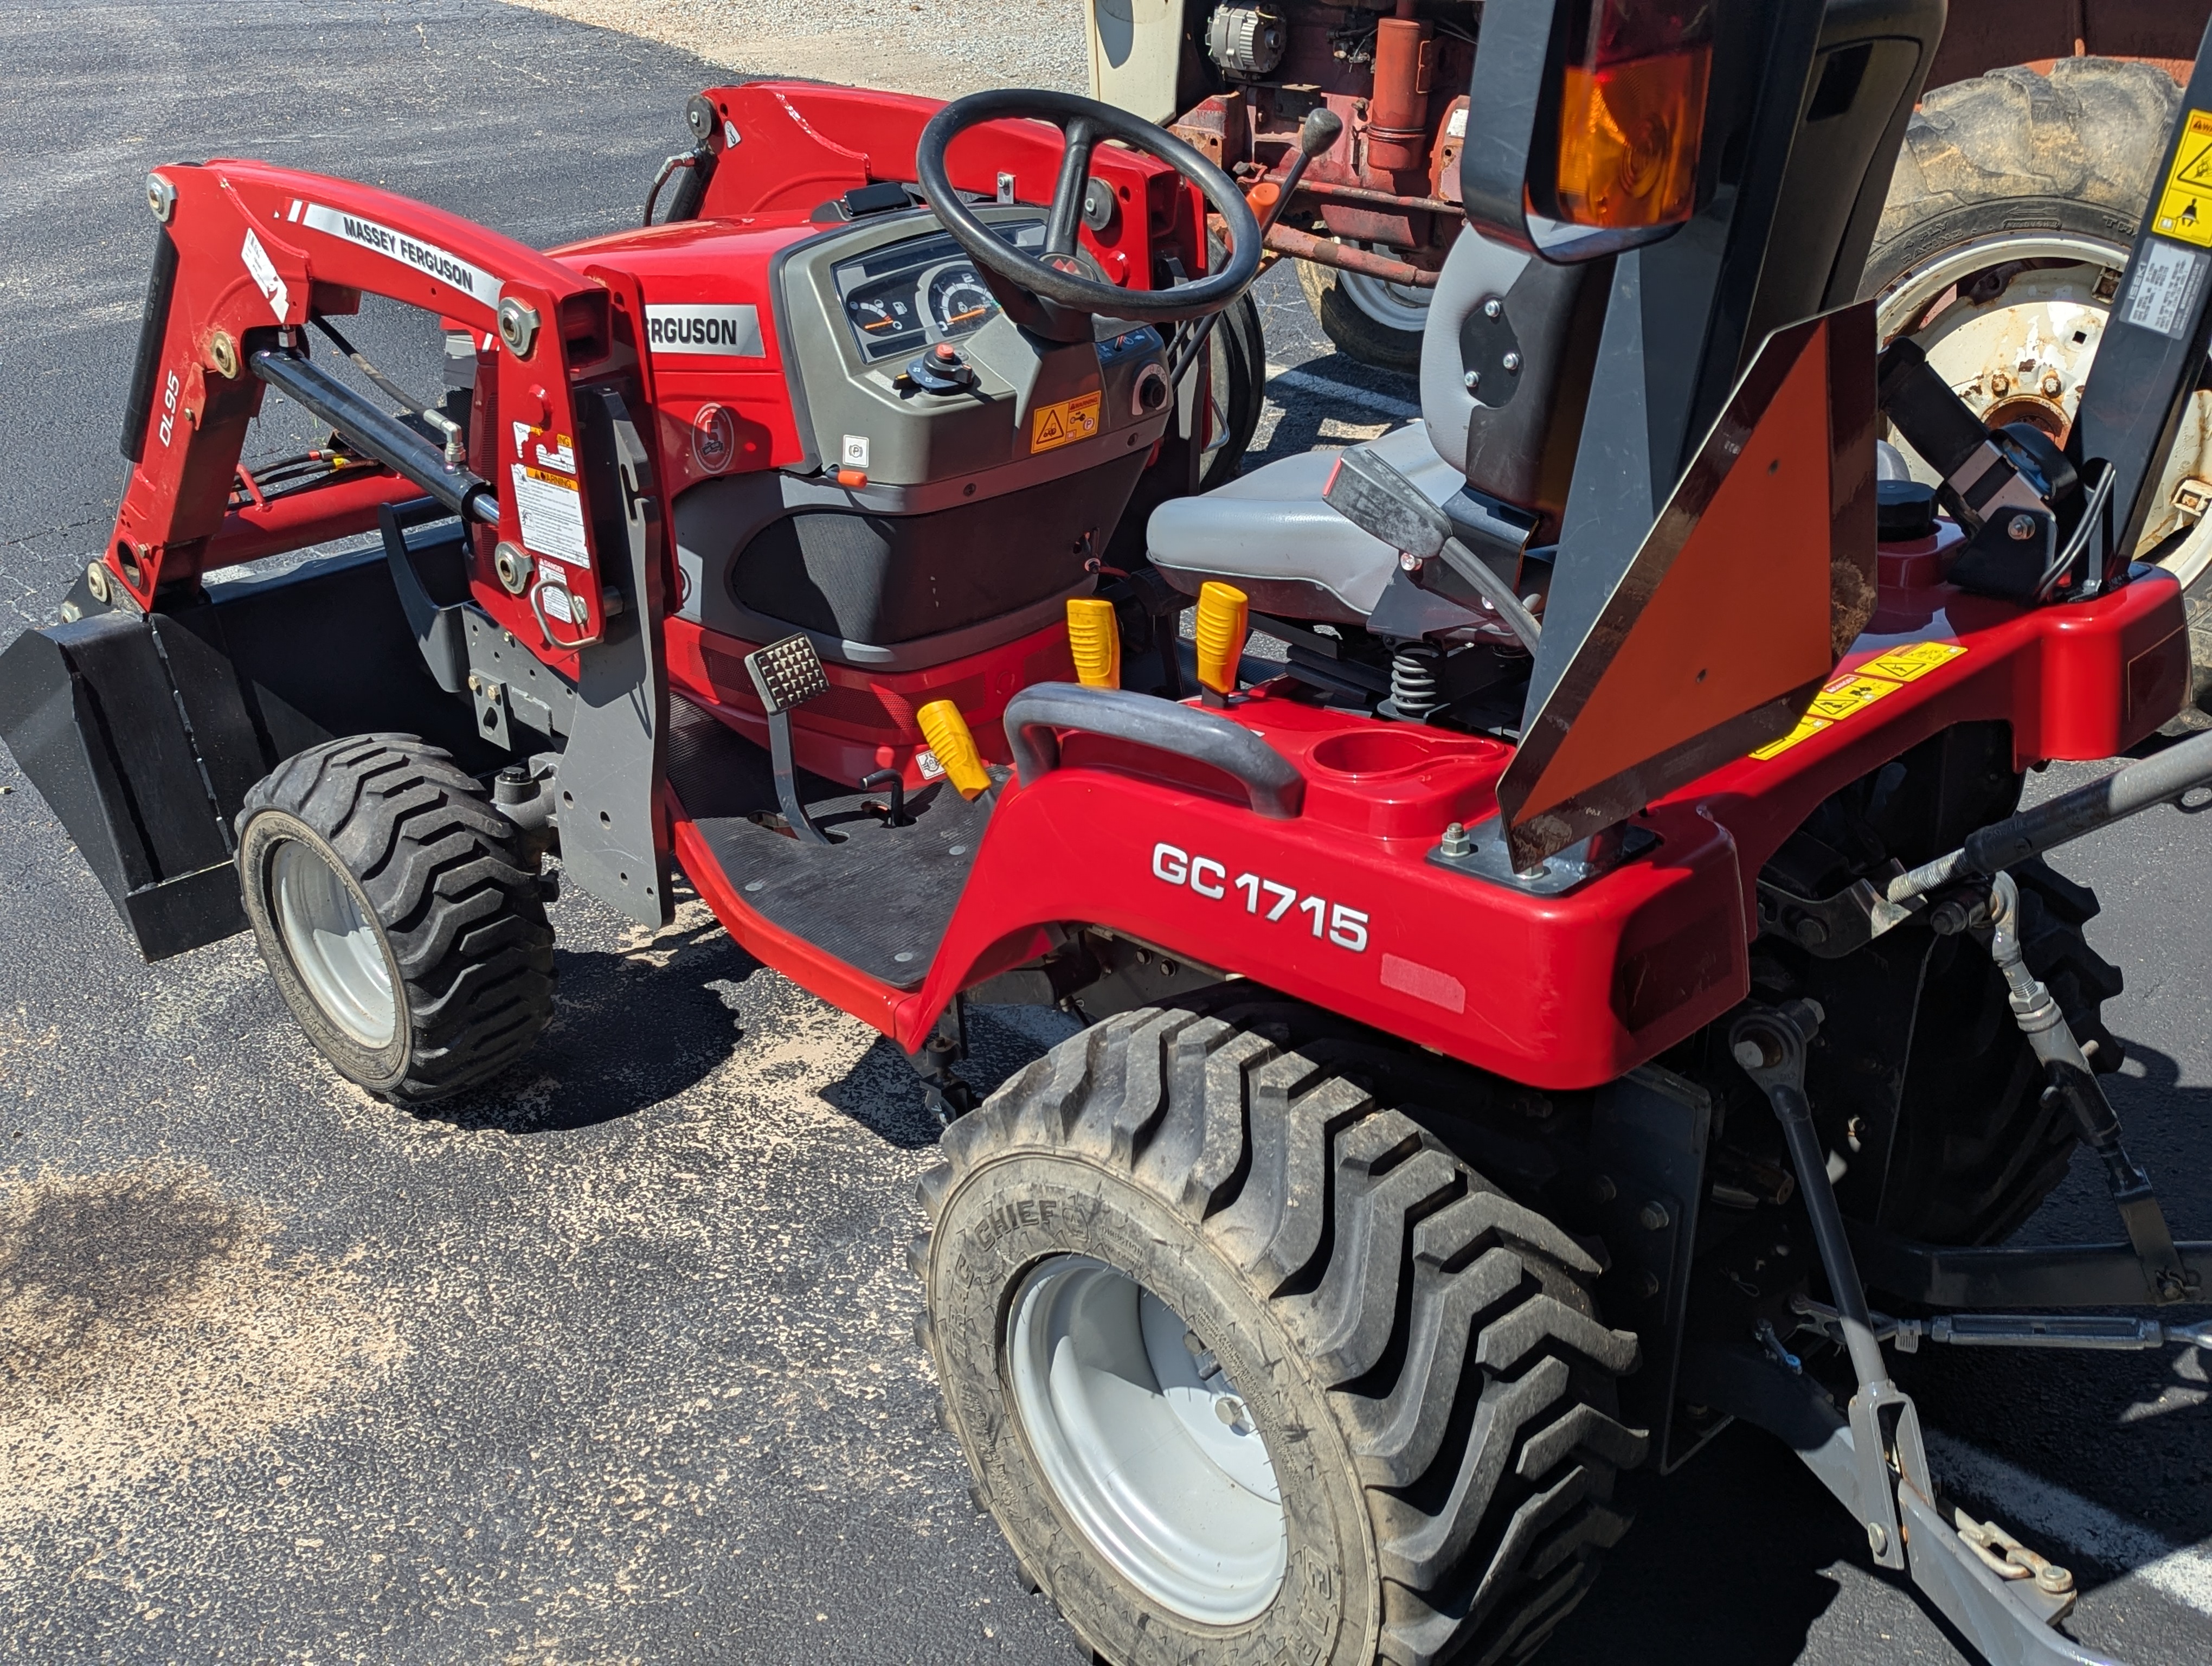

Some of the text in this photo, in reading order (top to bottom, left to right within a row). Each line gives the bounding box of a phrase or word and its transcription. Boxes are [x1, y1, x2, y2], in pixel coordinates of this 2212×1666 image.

[344, 216, 474, 292] MASSEY FERGUSON
[2127, 260, 2147, 300] ISEKI
[649, 317, 737, 345] RGUSON
[1075, 397, 1098, 409] WARNING
[542, 473, 572, 488] ARNING
[974, 1200, 1057, 1251] CHIEF
